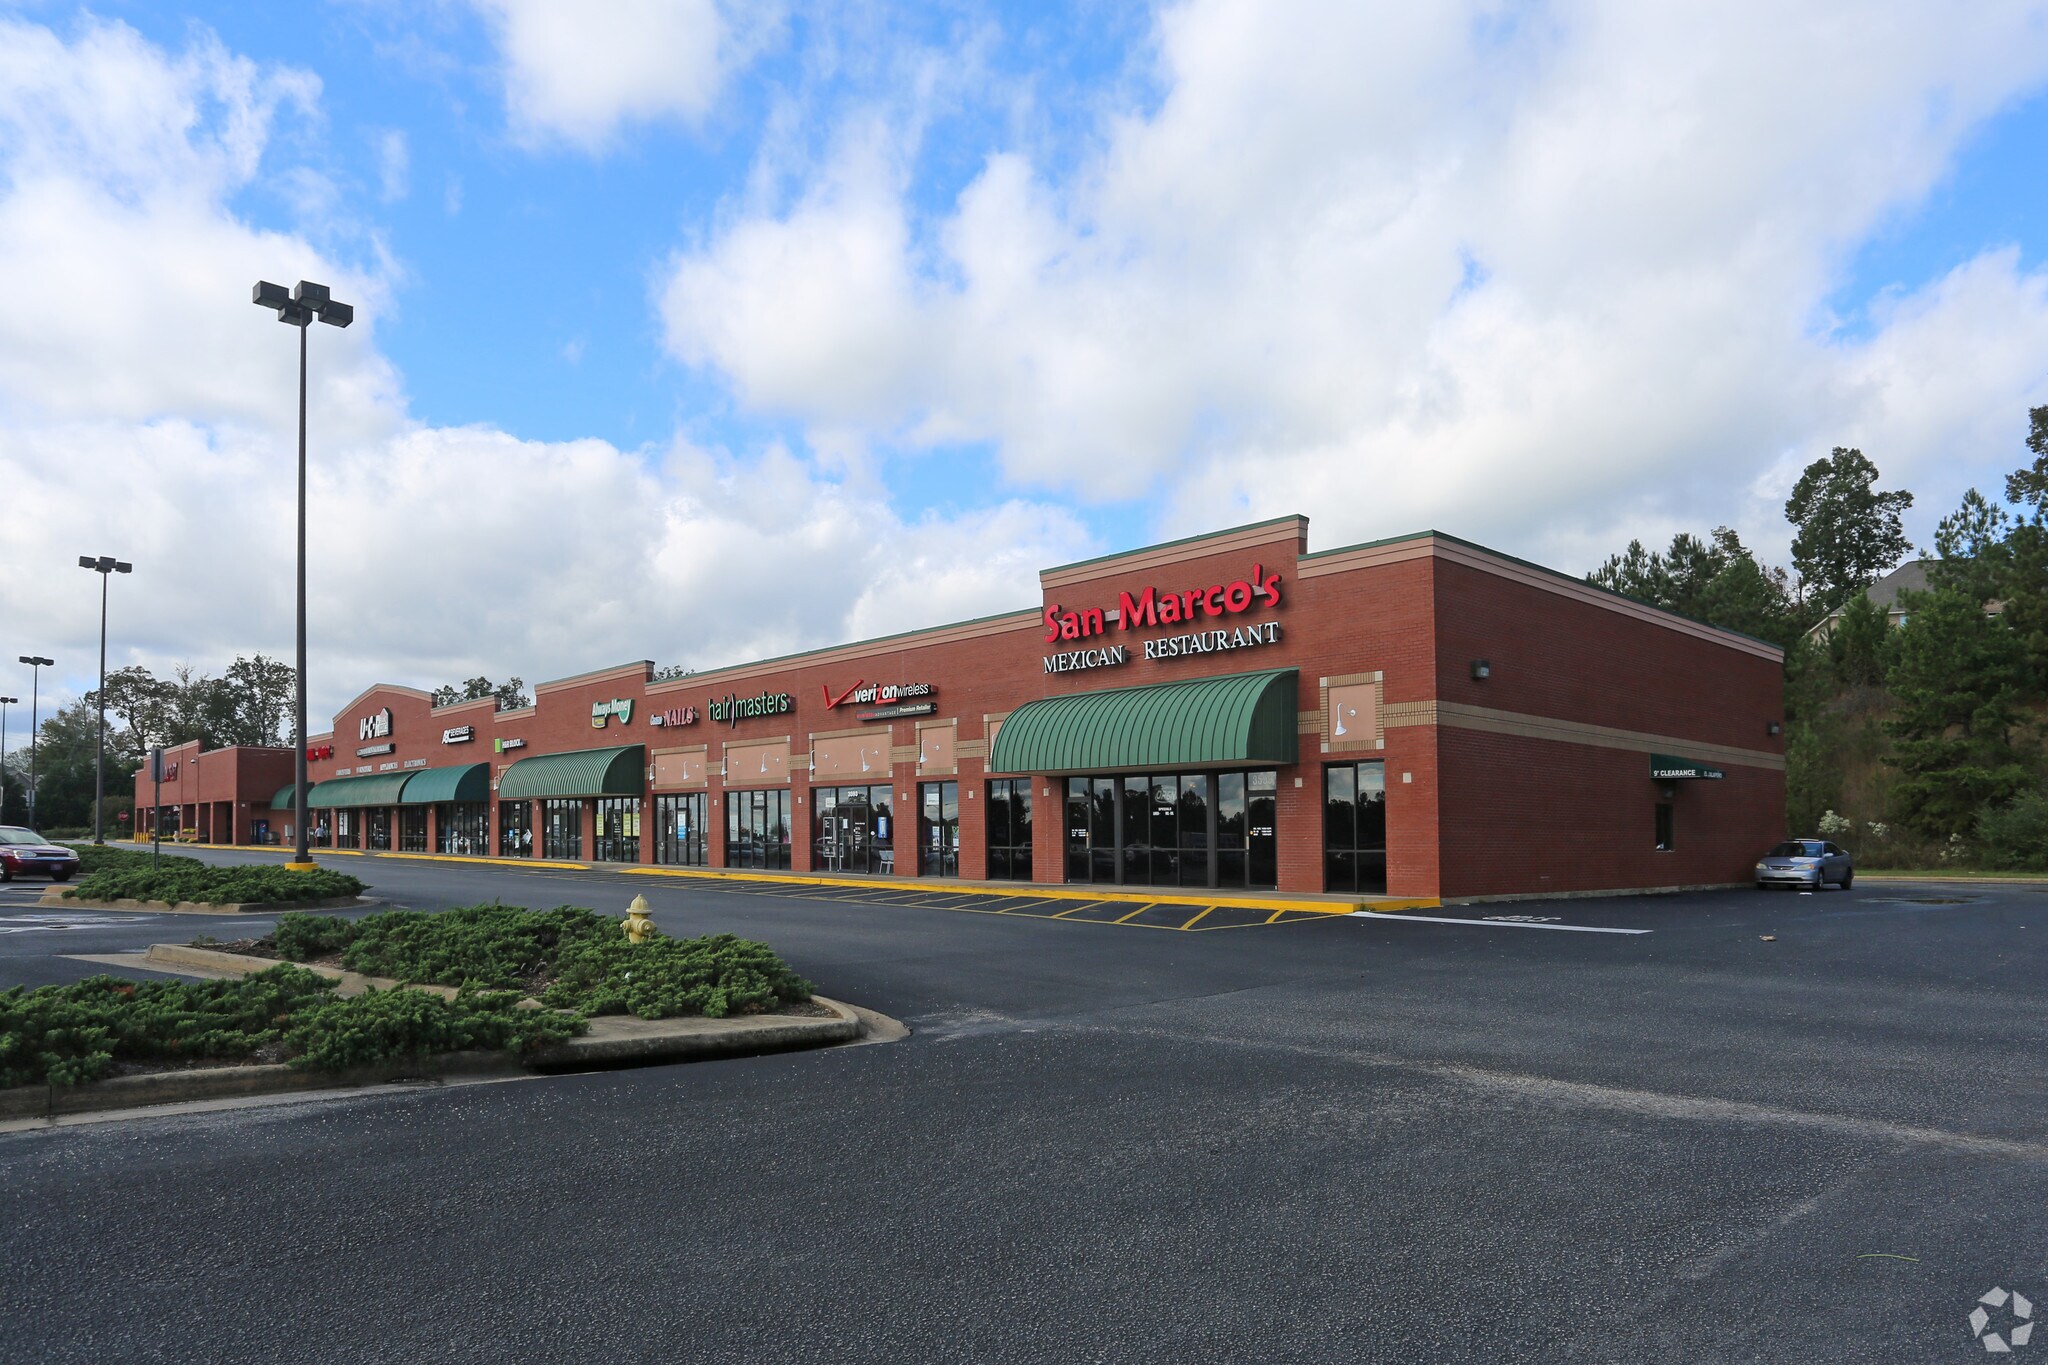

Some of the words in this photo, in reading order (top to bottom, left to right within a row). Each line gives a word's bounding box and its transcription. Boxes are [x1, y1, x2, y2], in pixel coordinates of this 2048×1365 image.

[1044, 603, 1104, 643] San
[1118, 563, 1282, 631] Marco's
[1043, 645, 1126, 674] MEXICAN
[1143, 622, 1280, 660] RESTAURANT
[855, 683, 897, 704] verizon
[896, 682, 929, 698] wireless
[592, 701, 611, 717] Always
[611, 698, 632, 716] Money
[663, 706, 694, 727] NAILS
[899, 705, 916, 713] Premium
[916, 703, 931, 711] Retailer
[449, 725, 469, 737] BEVERAGES
[509, 738, 523, 748] BLOCK
[1660, 769, 1696, 777] CLEARANCE
